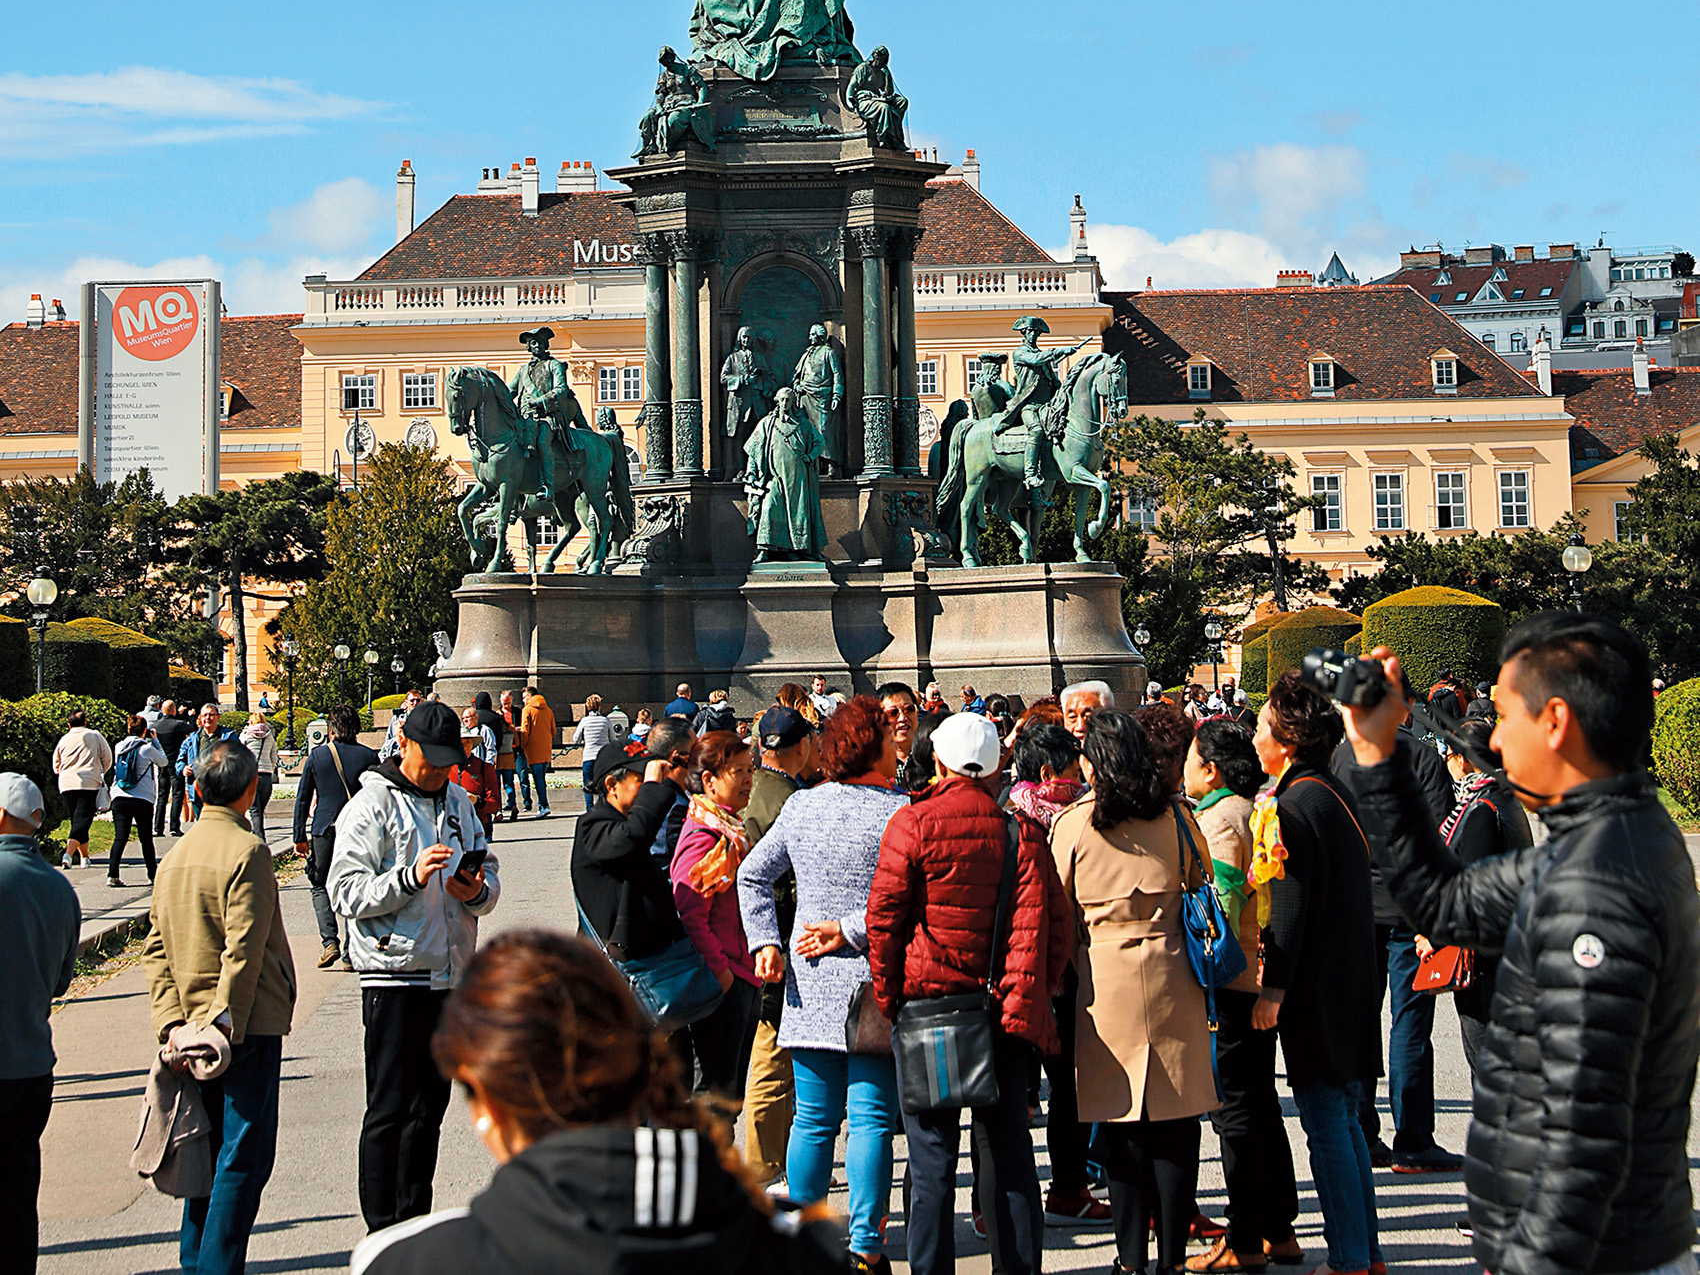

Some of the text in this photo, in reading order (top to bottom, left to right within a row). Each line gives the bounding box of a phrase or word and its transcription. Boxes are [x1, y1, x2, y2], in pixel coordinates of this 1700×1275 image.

[119, 291, 193, 338] MQ
[126, 321, 193, 347] MuseumsQuartier
[151, 336, 173, 348] Wien
